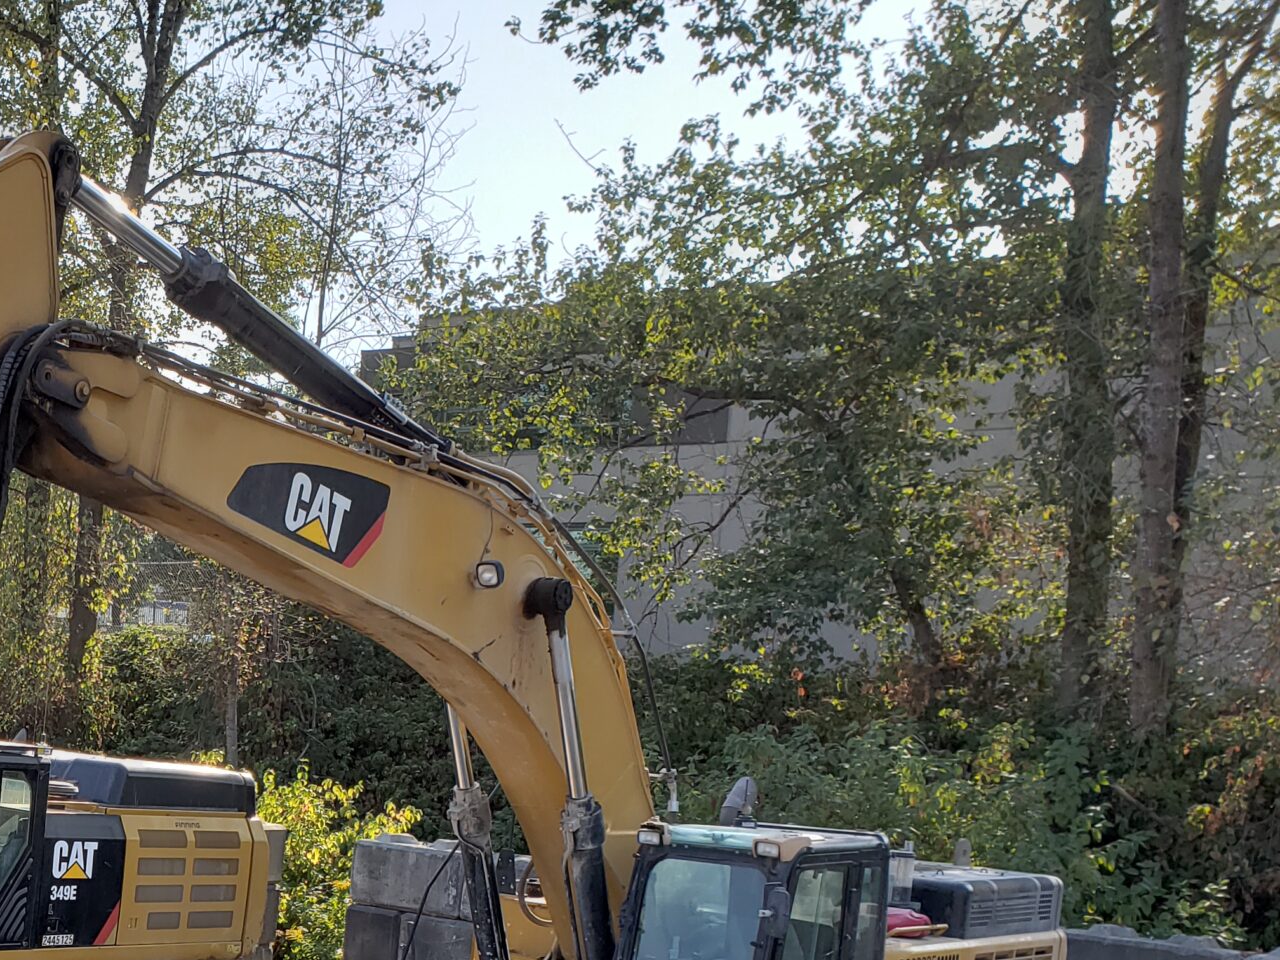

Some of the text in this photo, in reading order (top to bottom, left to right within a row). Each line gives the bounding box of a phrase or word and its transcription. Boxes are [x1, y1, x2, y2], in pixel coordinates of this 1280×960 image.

[285, 472, 352, 553] CAT
[52, 840, 99, 879] CAT
[50, 885, 77, 901] 349E
[42, 934, 74, 946] 2445125
